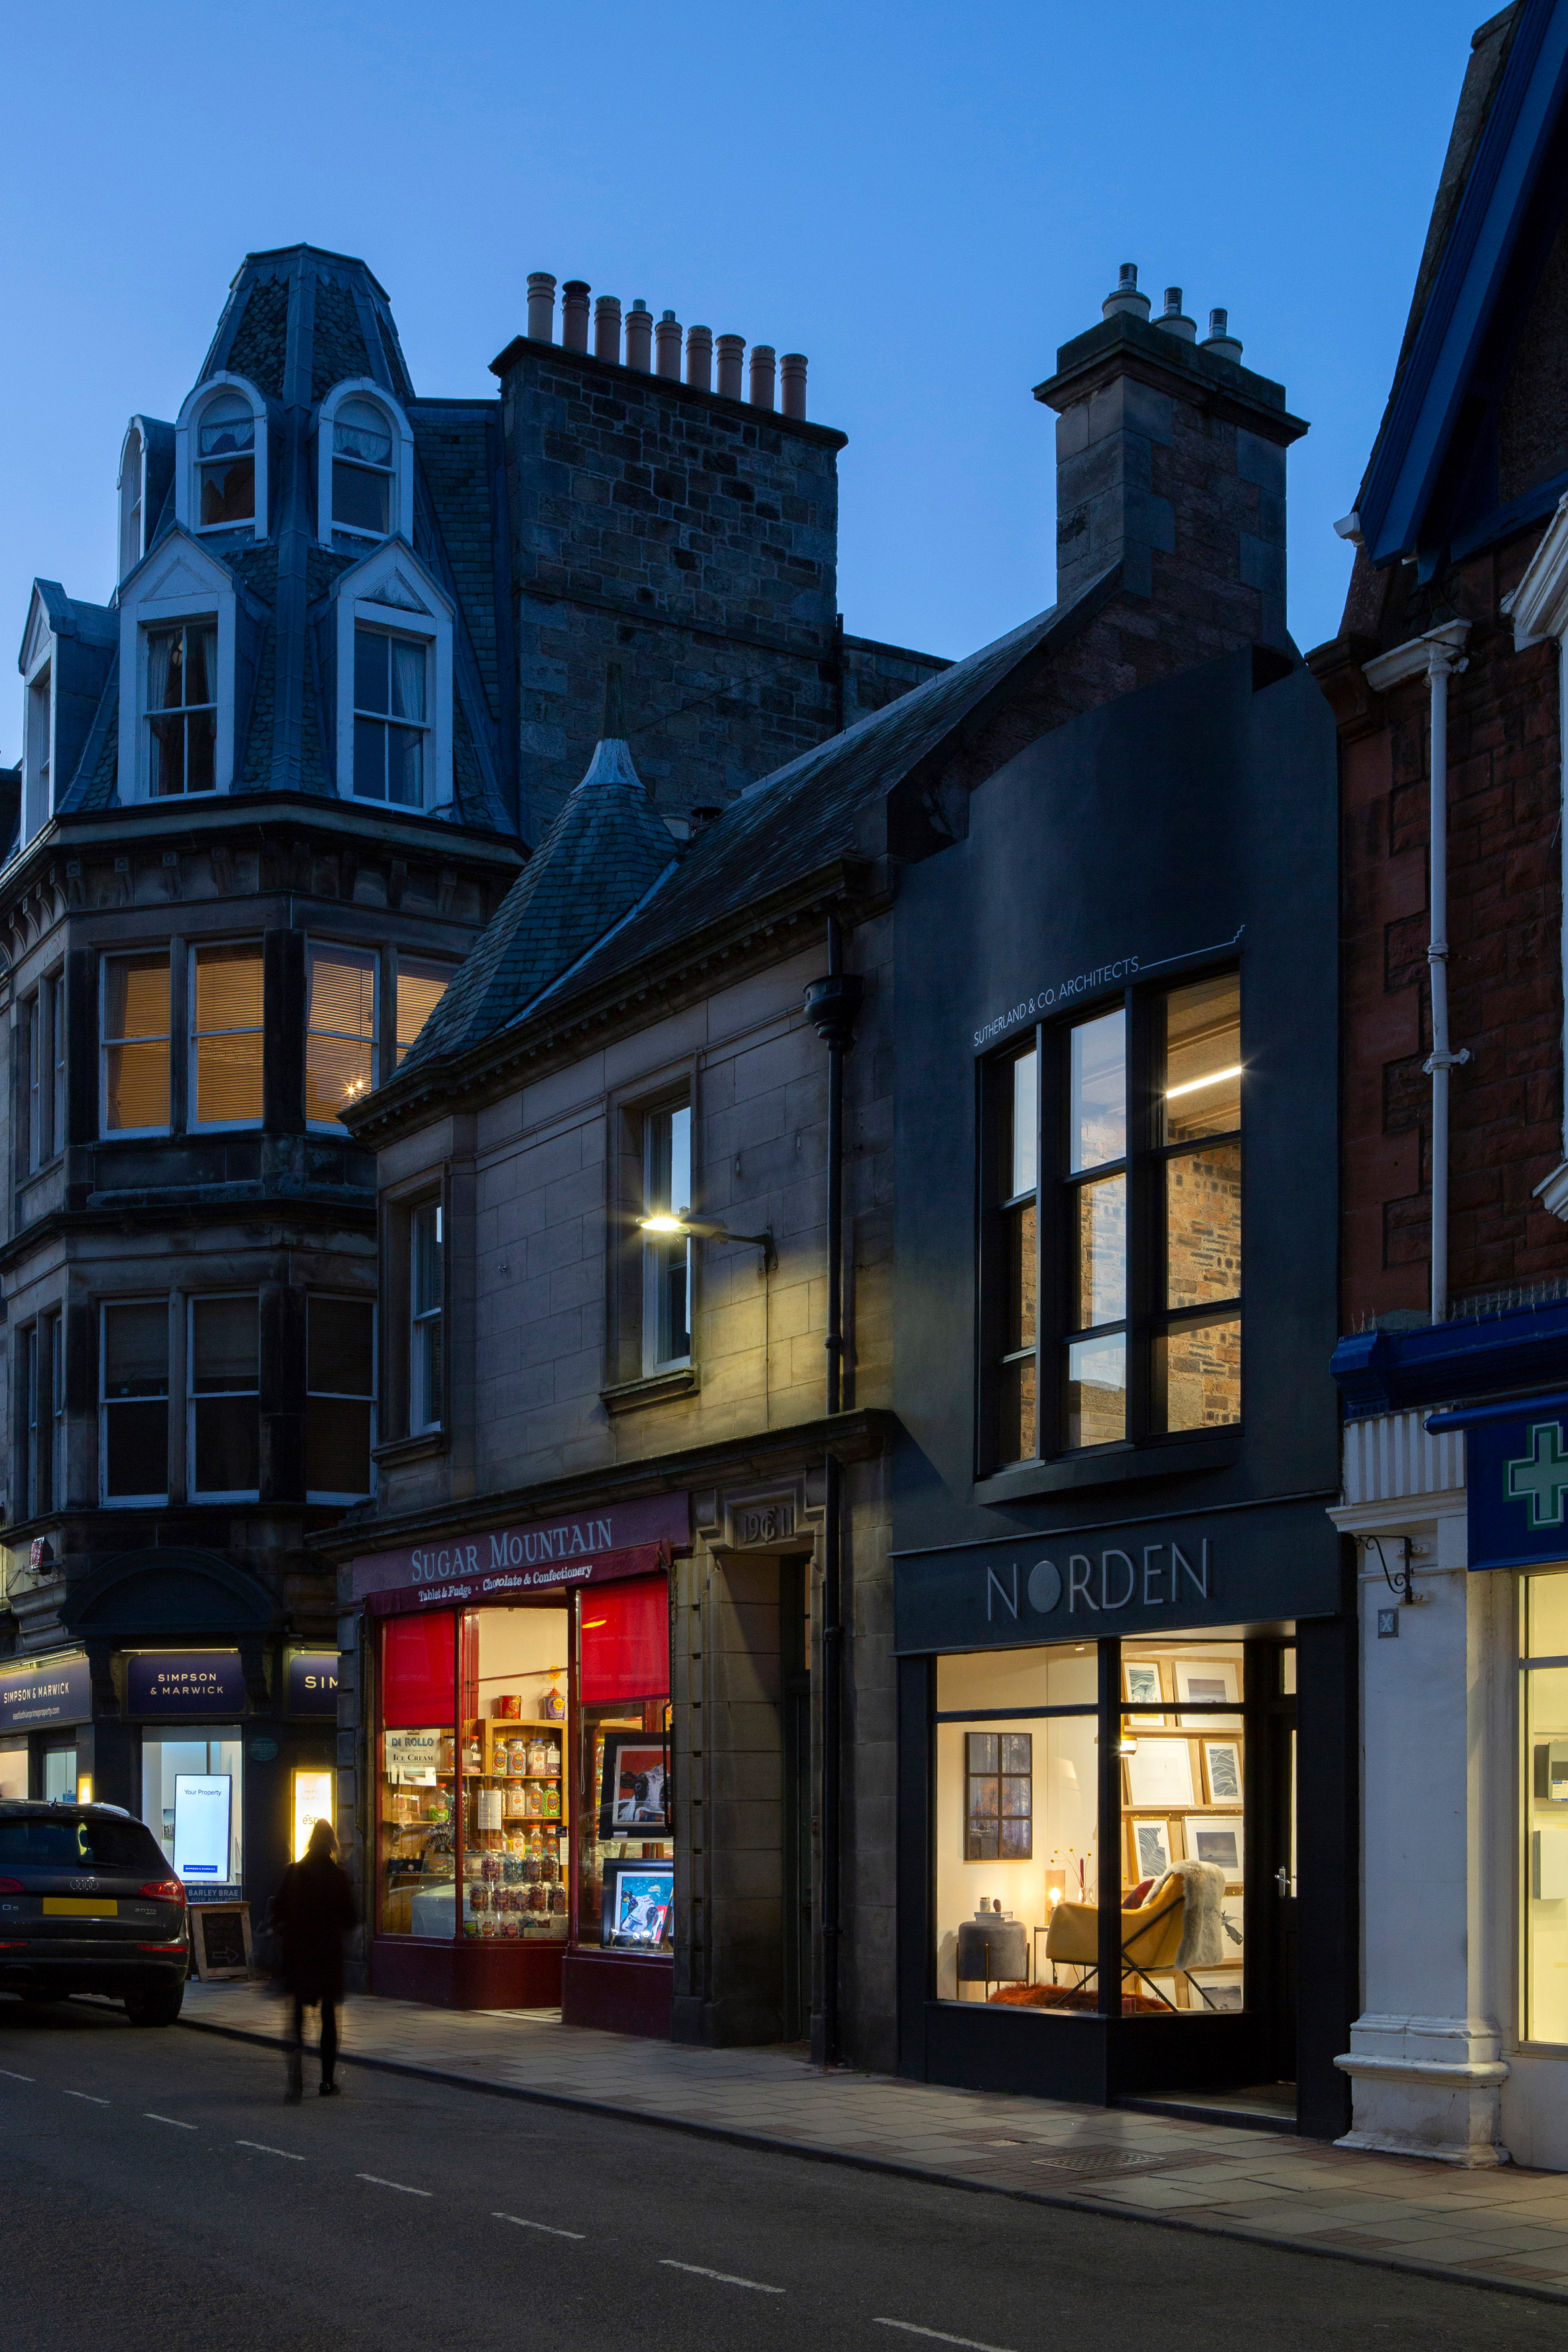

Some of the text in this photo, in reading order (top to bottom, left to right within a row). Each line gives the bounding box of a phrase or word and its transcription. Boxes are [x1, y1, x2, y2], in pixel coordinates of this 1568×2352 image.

[974, 955, 1140, 1047] SUTHERLAND & CO. ARCHITECTS
[412, 1518, 612, 1582] SUGAR MOUNTAIN
[419, 1565, 592, 1602] Tablet & Fudge Chocolate & Confectionery
[987, 1537, 1207, 1621] NORDEN
[3, 1681, 70, 1704] SIMPSON & MARWICK
[158, 1673, 217, 1682] SIMPSON
[163, 1685, 224, 1695] MARWICK
[391, 1737, 434, 1746] DI ROLLO
